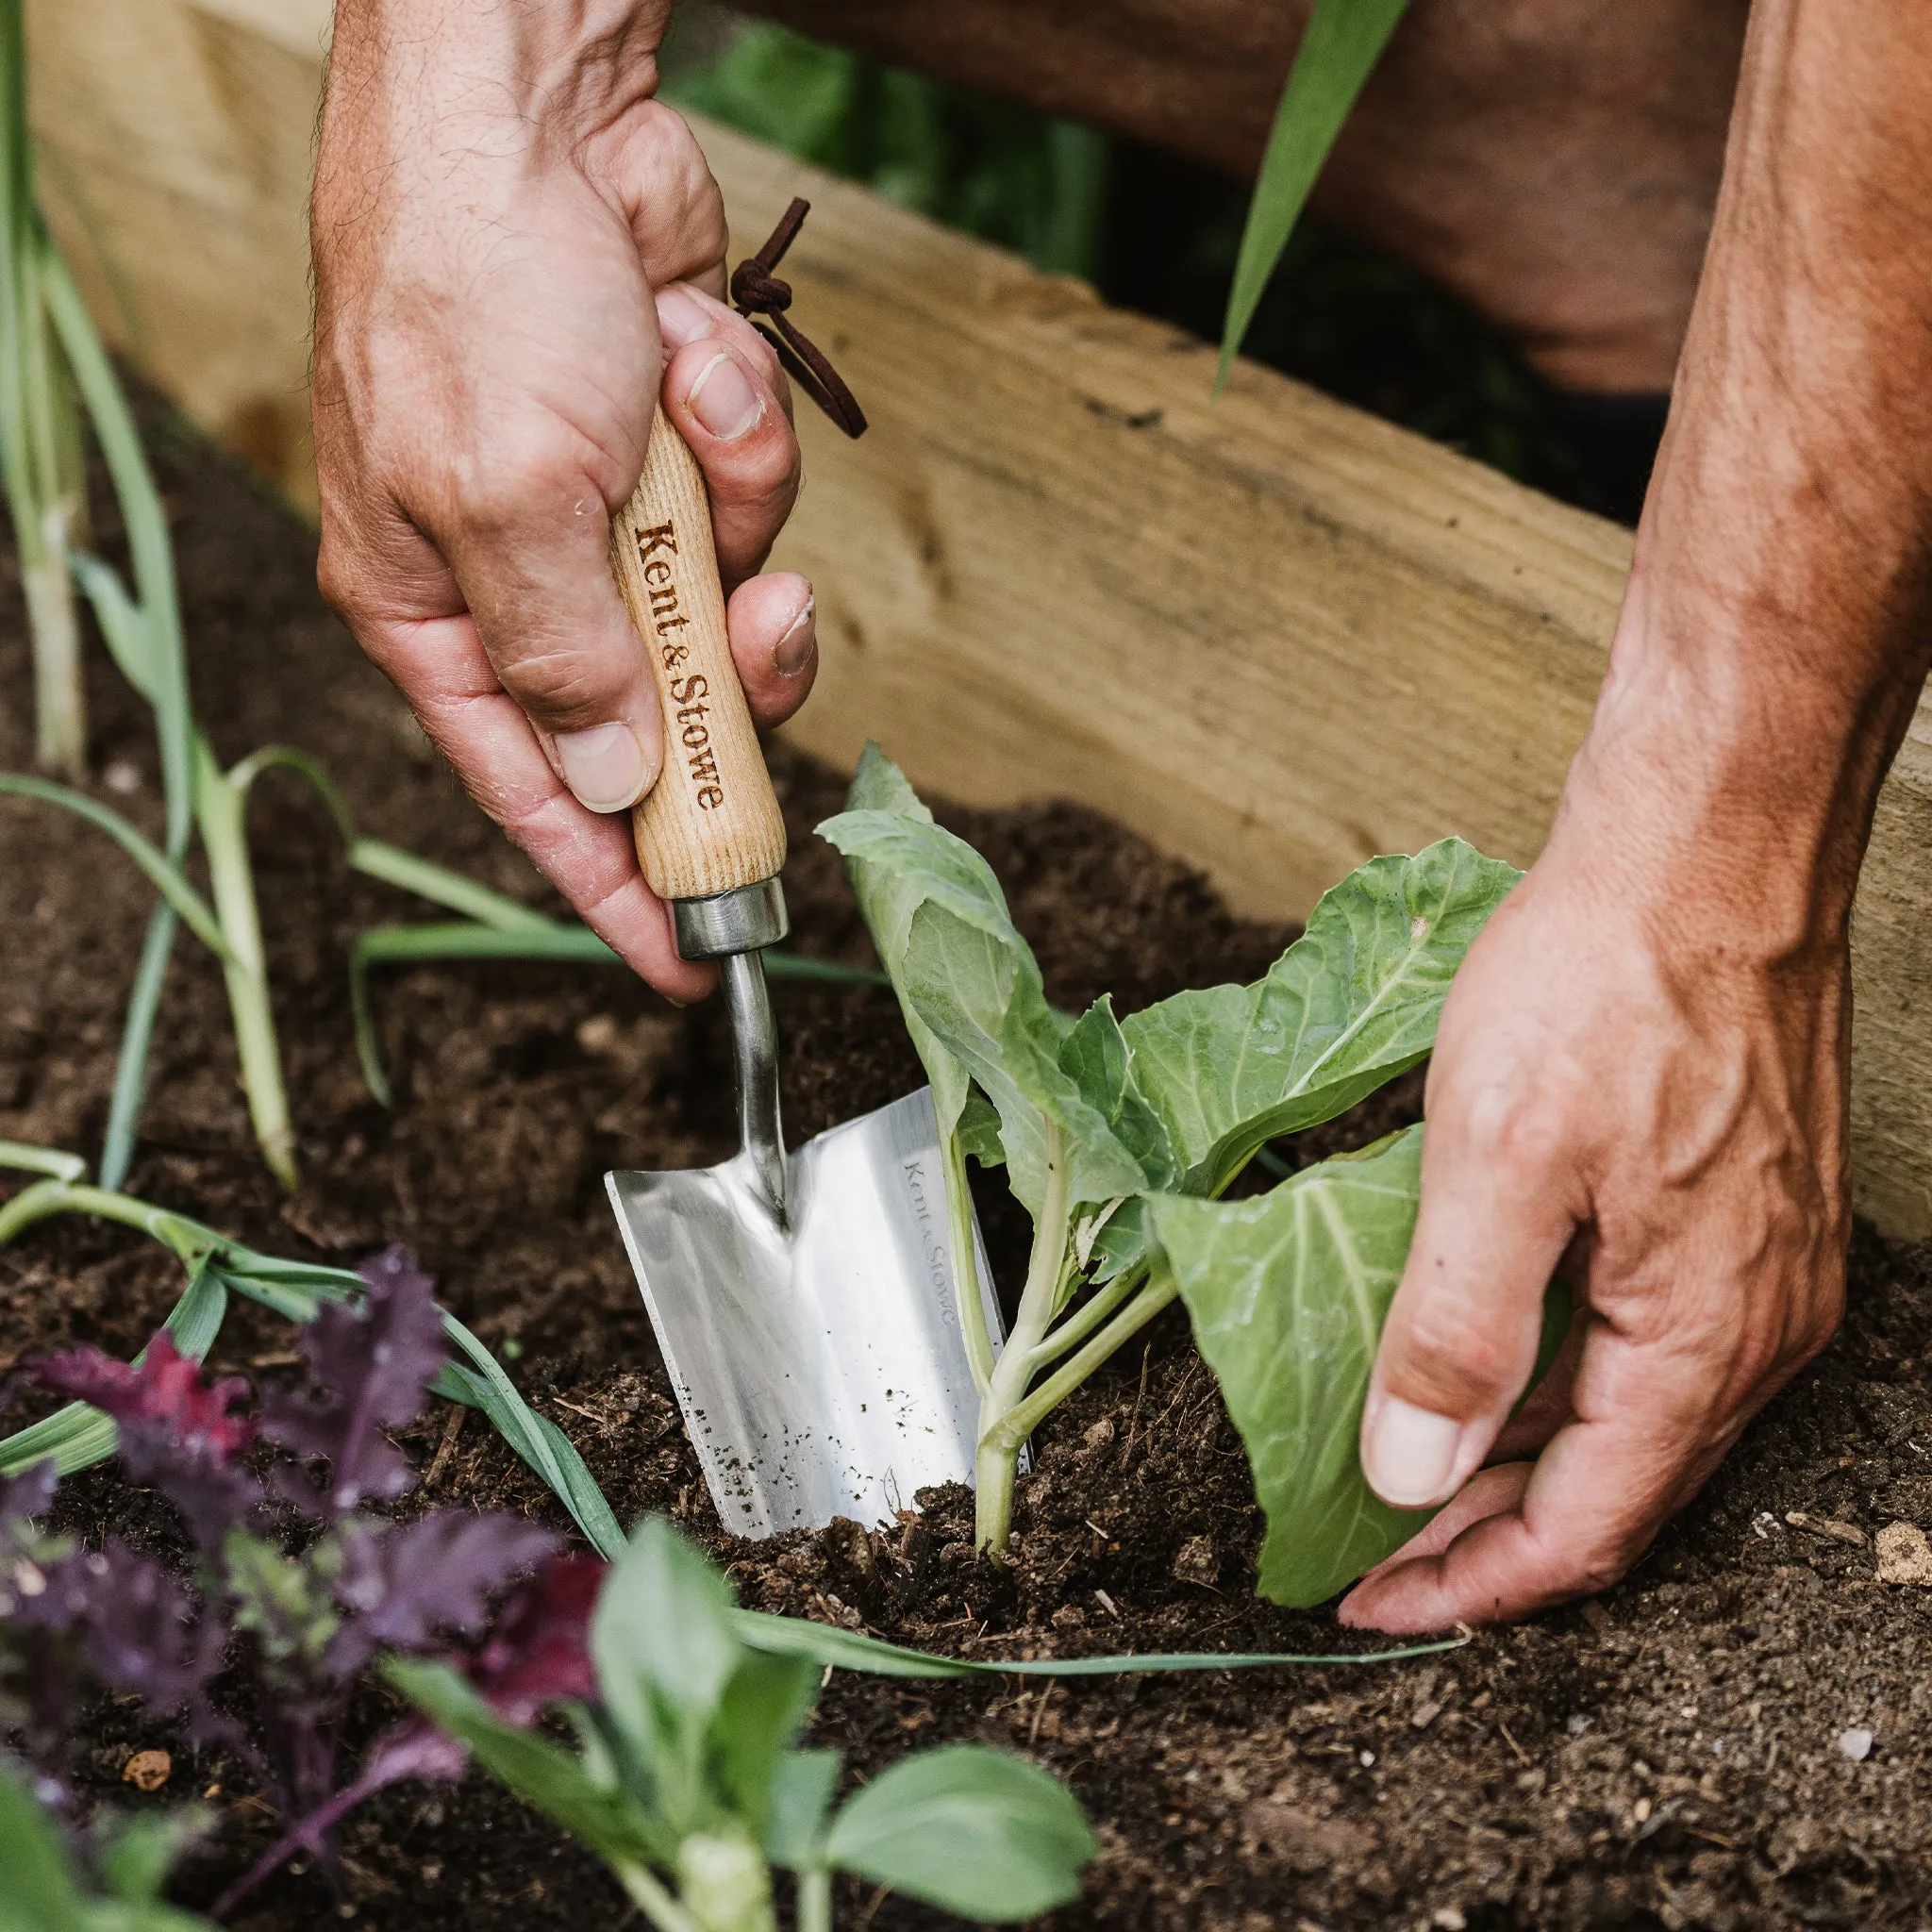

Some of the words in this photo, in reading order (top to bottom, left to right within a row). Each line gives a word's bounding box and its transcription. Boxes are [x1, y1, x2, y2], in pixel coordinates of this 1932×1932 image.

[635, 519, 690, 637] Kent
[662, 644, 690, 672] &
[670, 675, 724, 811] Stowe
[903, 1161, 932, 1223] Kent
[926, 1245, 956, 1326] Stowe
